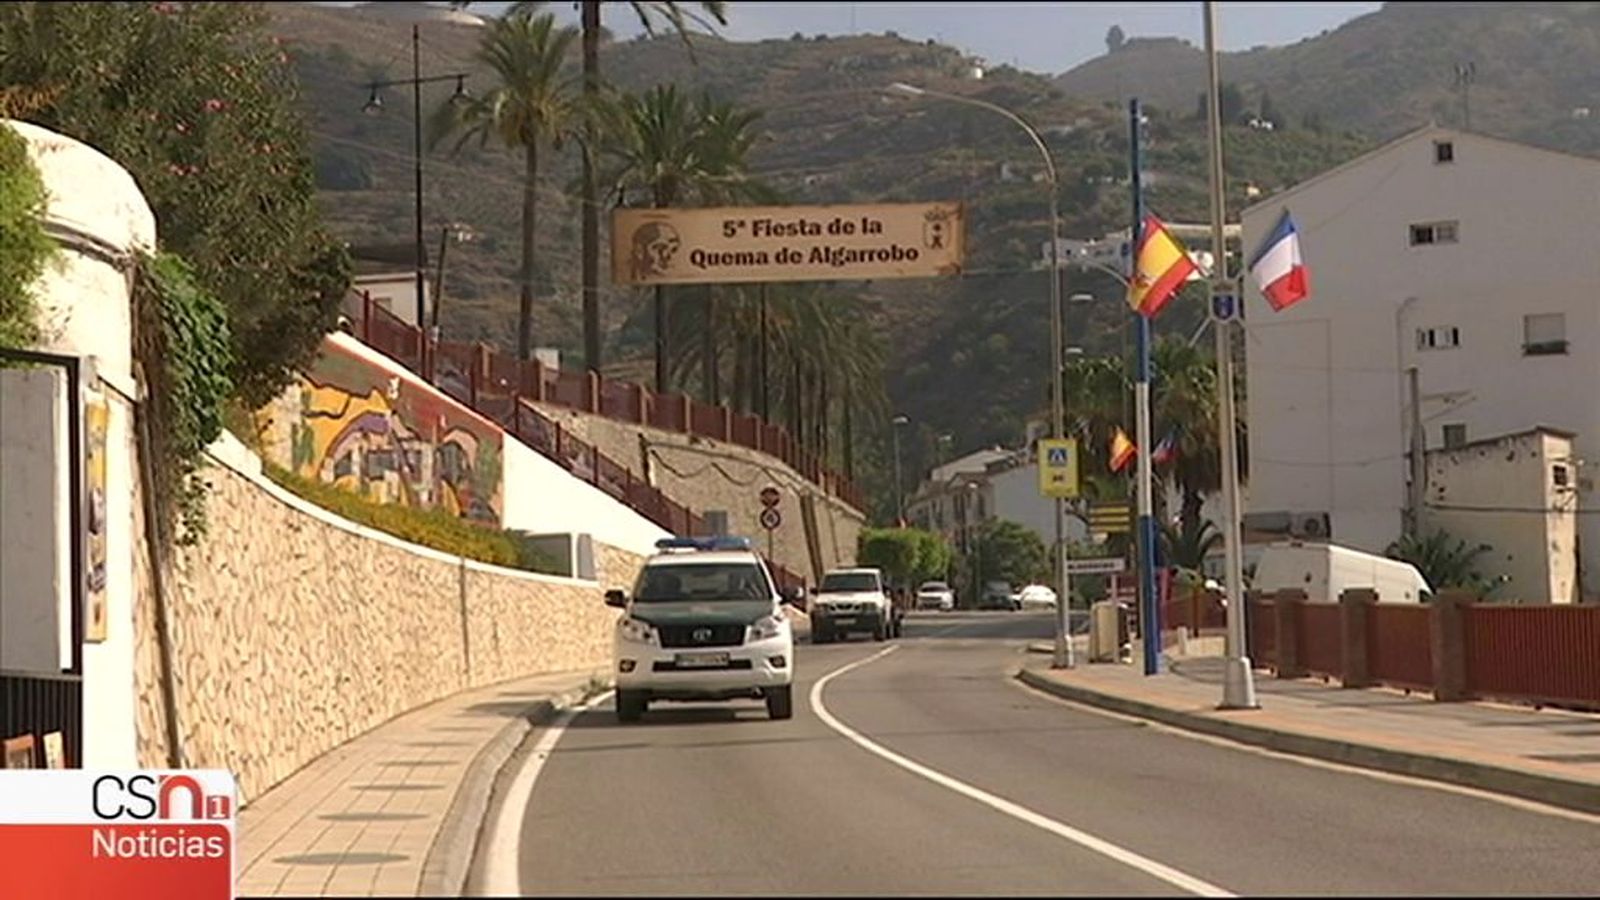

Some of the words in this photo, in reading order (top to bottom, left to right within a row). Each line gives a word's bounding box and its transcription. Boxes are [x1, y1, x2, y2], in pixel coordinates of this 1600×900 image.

[752, 219, 822, 237] Fiesta
[827, 218, 855, 235] de
[862, 217, 883, 234] la
[690, 249, 769, 269] Quema
[775, 247, 803, 264] de
[808, 244, 919, 267] Algarrobo
